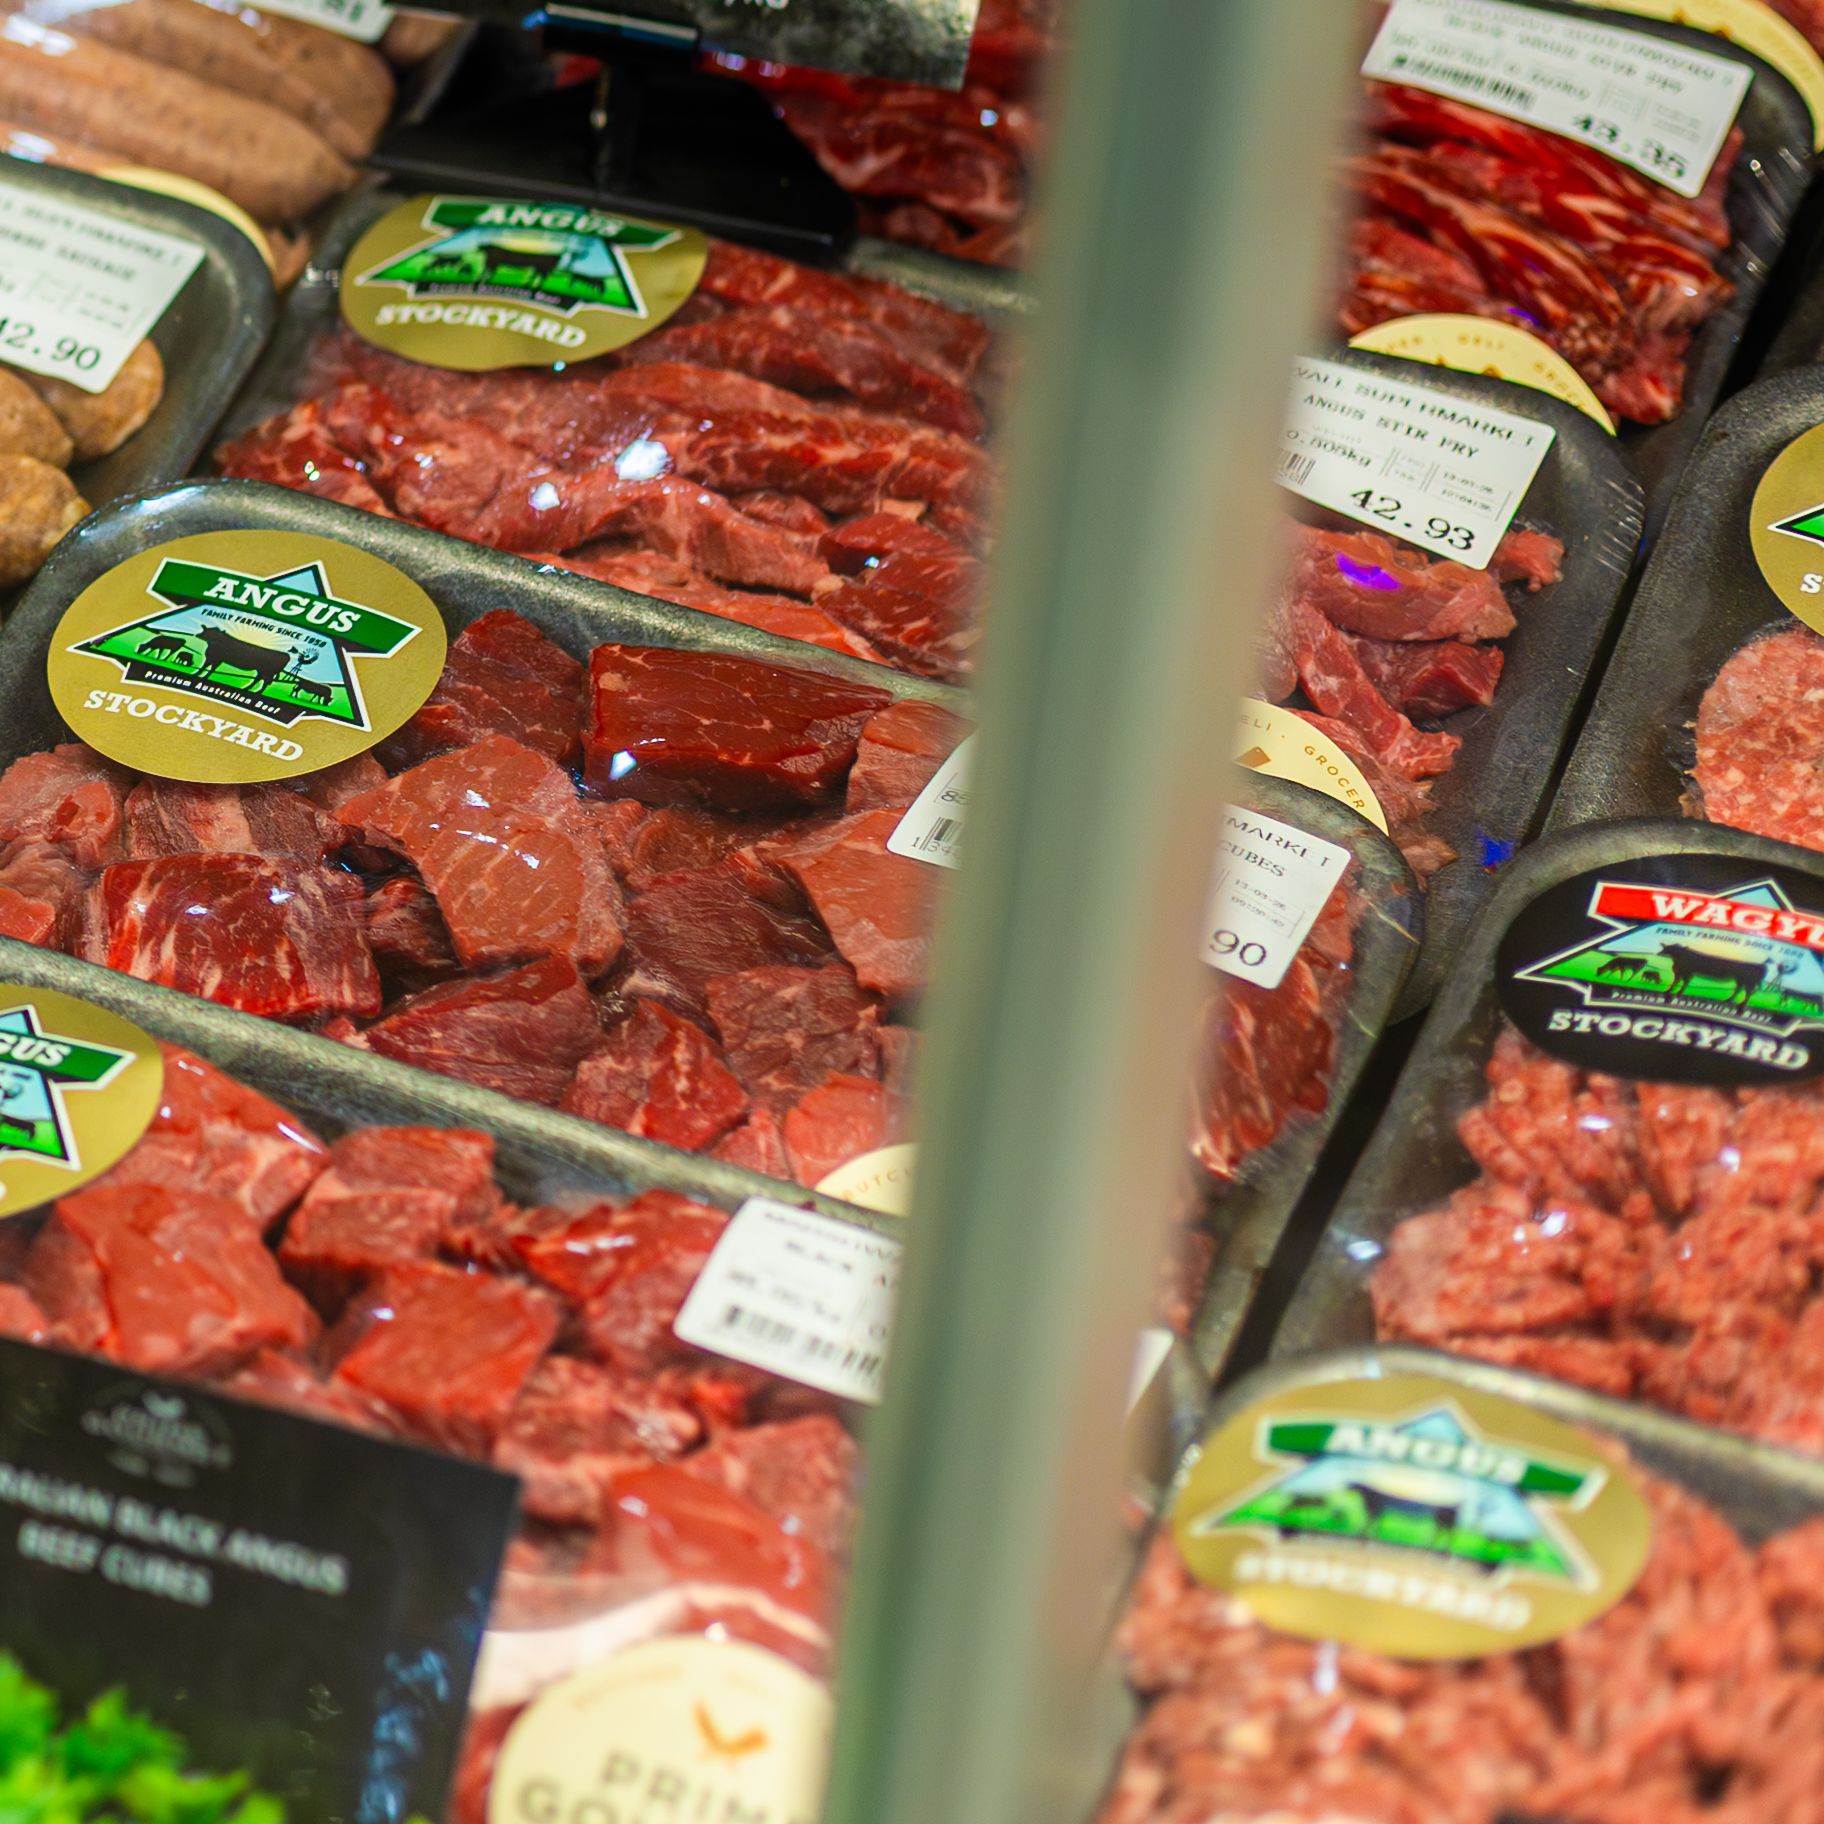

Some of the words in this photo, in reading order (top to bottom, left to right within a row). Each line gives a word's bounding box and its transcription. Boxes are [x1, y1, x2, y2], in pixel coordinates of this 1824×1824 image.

[475, 204, 627, 239] ANGUS
[375, 303, 587, 348] STOCKYARD
[1304, 395, 1364, 420] ANGUS
[1439, 437, 1479, 459] FRY
[1350, 489, 1476, 551] 42.93
[201, 608, 233, 621] FAMILY
[235, 616, 274, 632] FARMING
[276, 627, 301, 640] SINCE
[204, 576, 361, 634] ANGUS
[145, 671, 191, 687] Premium
[196, 683, 252, 705] Australian
[255, 701, 280, 715] Beef
[83, 689, 303, 762] STOCKYARD
[1304, 745, 1365, 809] GROCER
[1216, 840, 1285, 877] CUBES
[1226, 817, 1330, 866] MARKET
[1209, 930, 1267, 966] 90
[1548, 1010, 1809, 1070] STOCKYARD
[16, 1521, 100, 1571] BEEF
[101, 1542, 212, 1607] CUBES
[114, 1495, 224, 1561] BLACK
[226, 1528, 349, 1596] ANGUS
